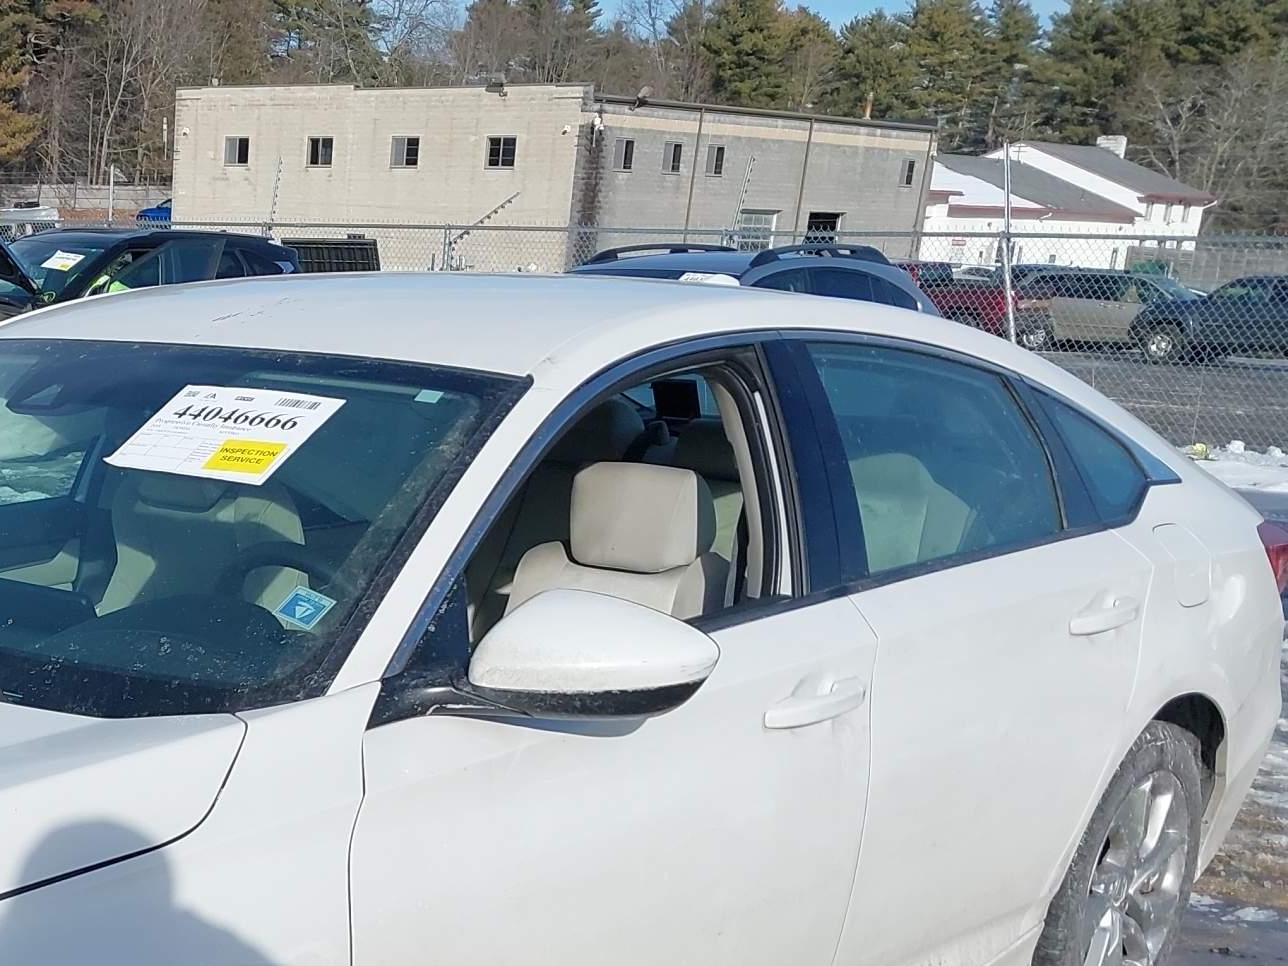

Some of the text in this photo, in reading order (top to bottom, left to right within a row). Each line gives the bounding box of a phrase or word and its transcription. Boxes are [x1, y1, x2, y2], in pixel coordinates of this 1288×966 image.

[173, 404, 305, 430] 44046666
[220, 447, 279, 457] INSPECTION
[219, 455, 265, 464] SERVICE
